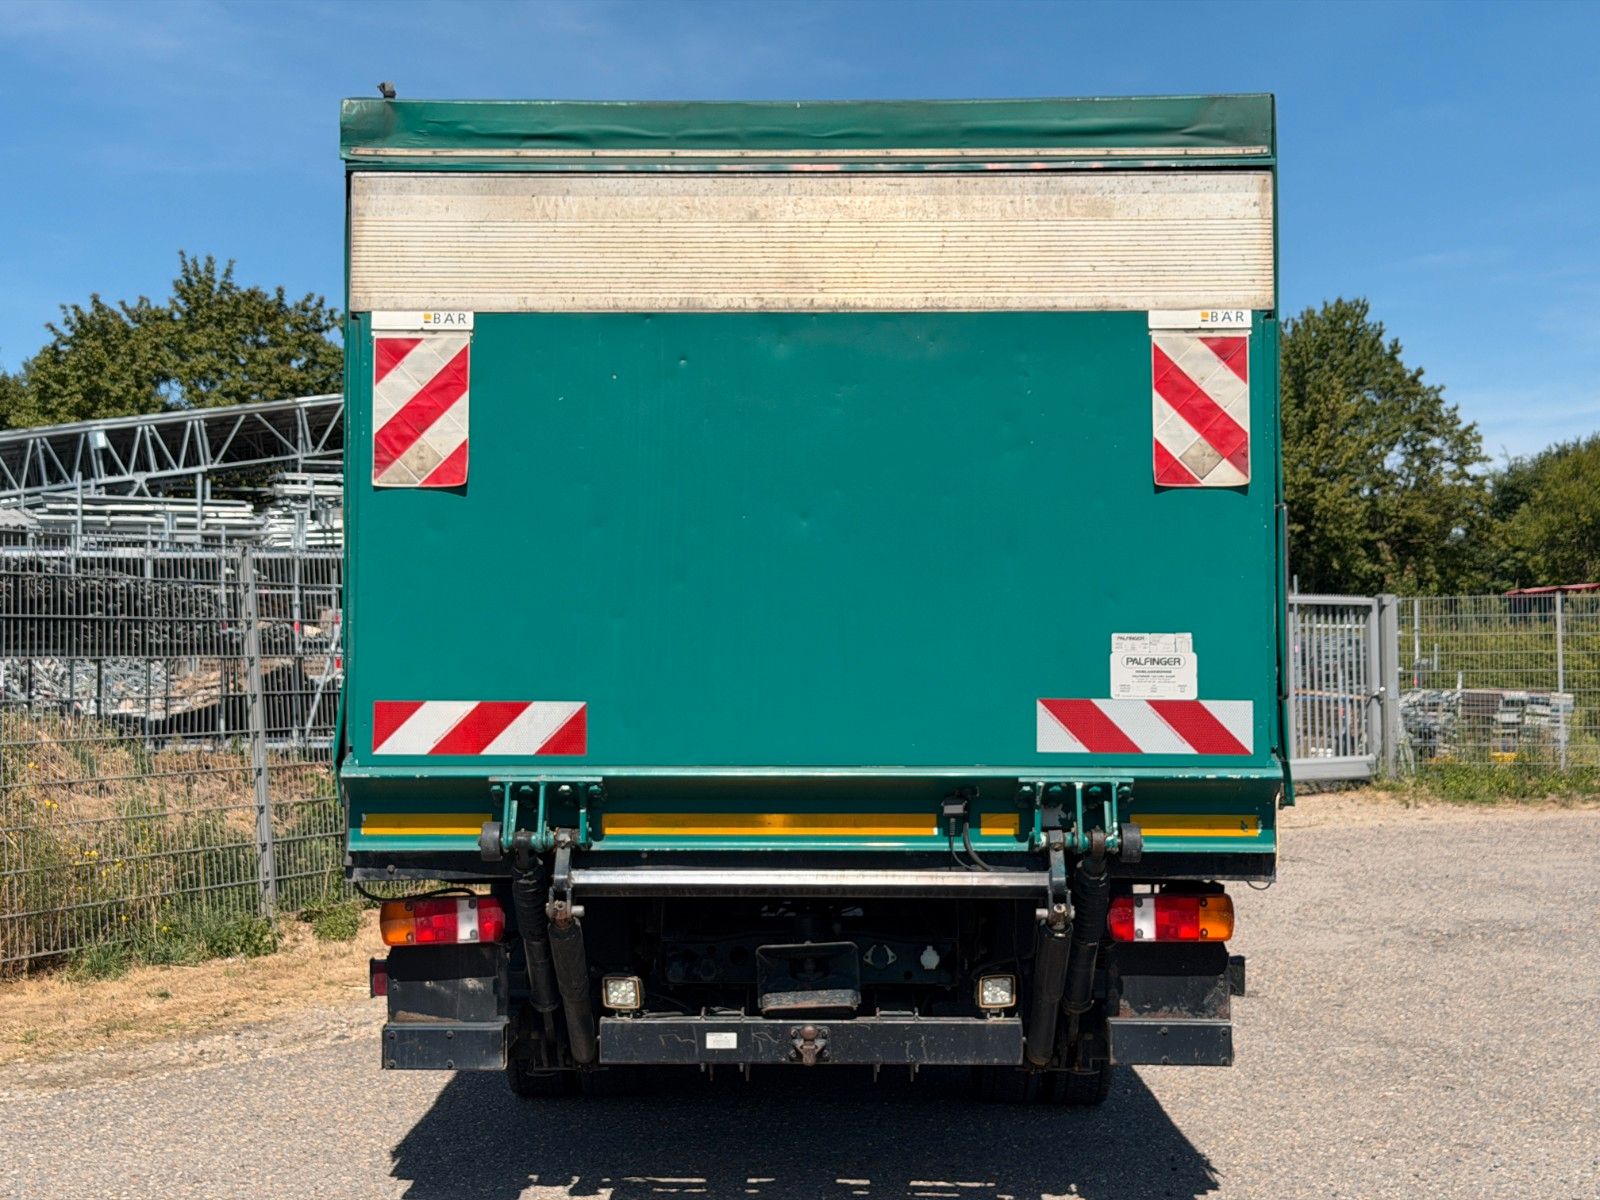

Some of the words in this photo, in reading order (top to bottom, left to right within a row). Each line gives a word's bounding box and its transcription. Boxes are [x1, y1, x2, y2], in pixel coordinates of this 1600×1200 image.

[433, 312, 467, 324] BÄR
[1210, 311, 1244, 322] BÄR
[1126, 657, 1181, 666] PALFINGER
